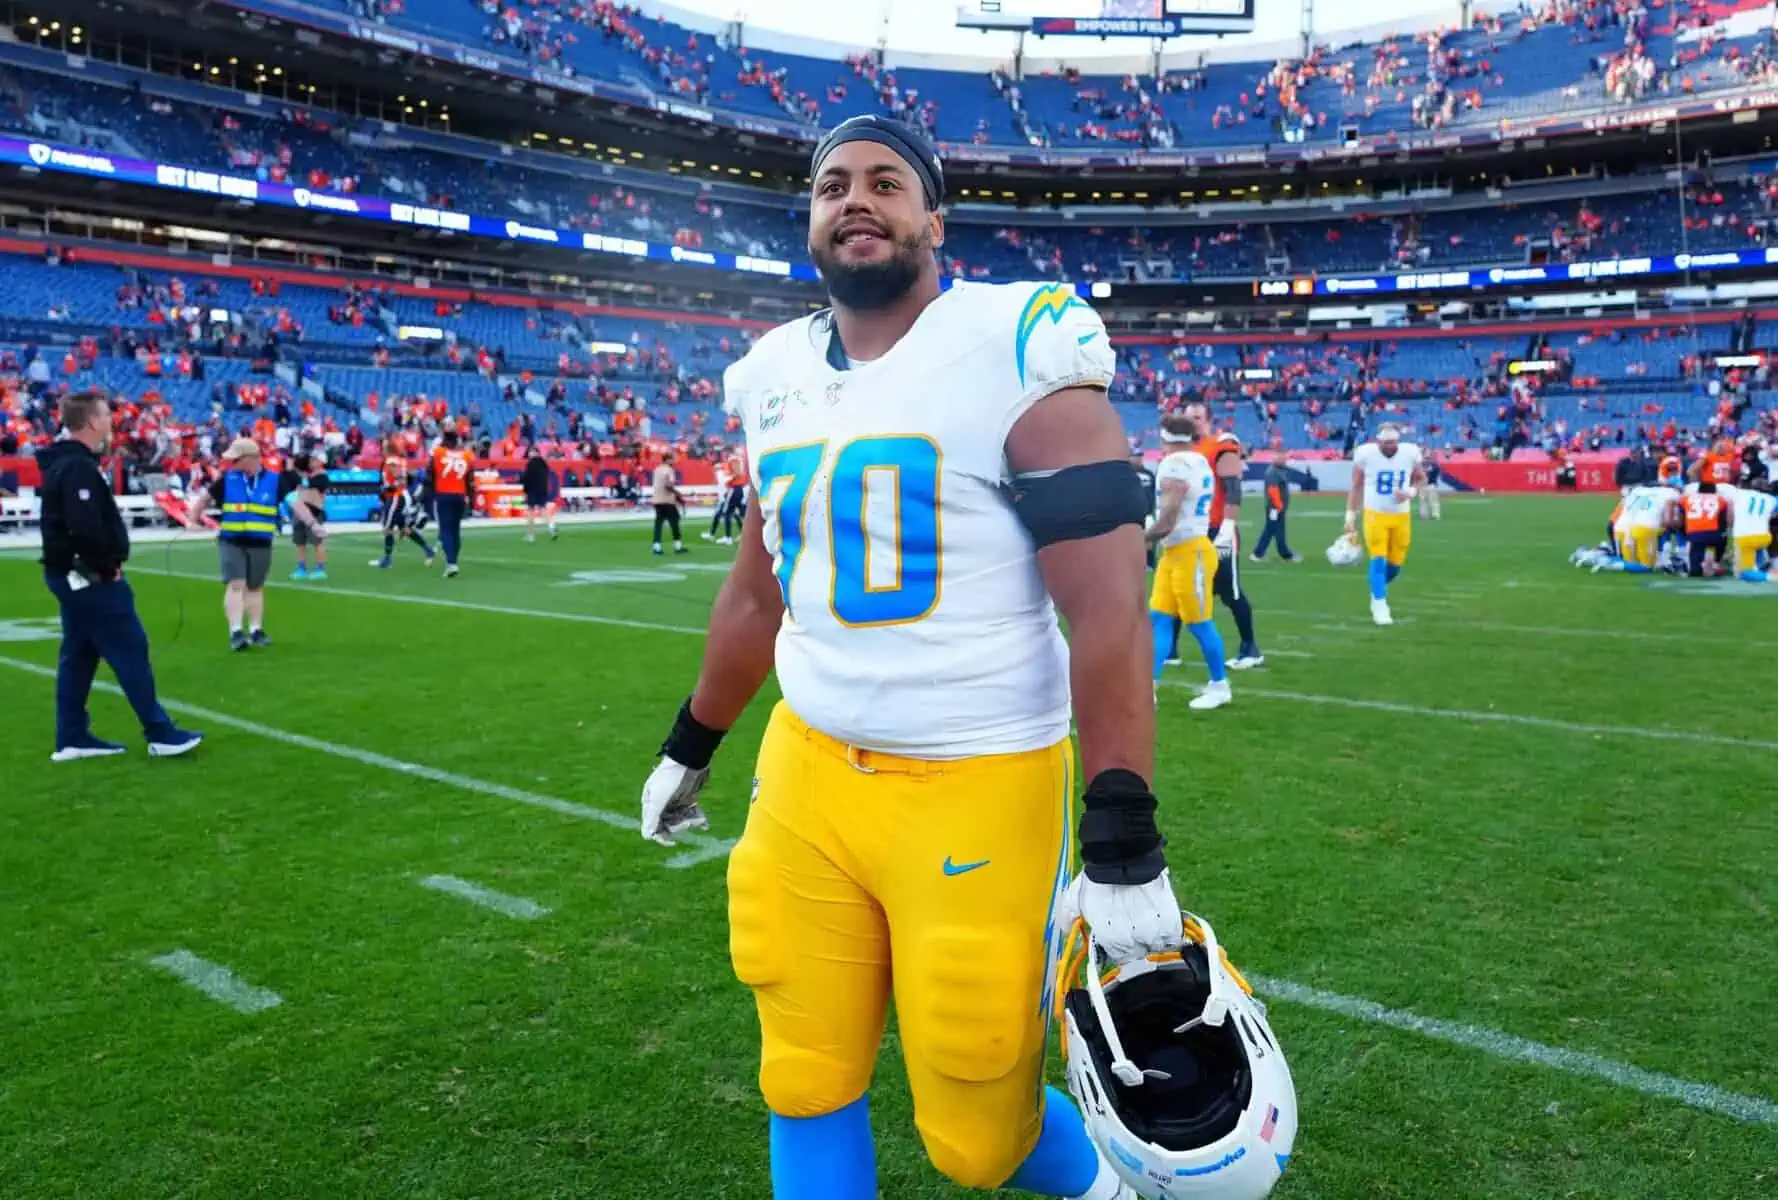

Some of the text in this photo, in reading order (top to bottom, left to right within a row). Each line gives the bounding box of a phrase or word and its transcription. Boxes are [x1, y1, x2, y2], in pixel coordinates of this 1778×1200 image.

[1075, 19, 1138, 33] EMPOWER
[440, 456, 468, 479] 79
[1376, 469, 1406, 496] 81
[1686, 492, 1719, 520] 39
[1747, 496, 1766, 516] 11
[758, 432, 944, 629] 70
